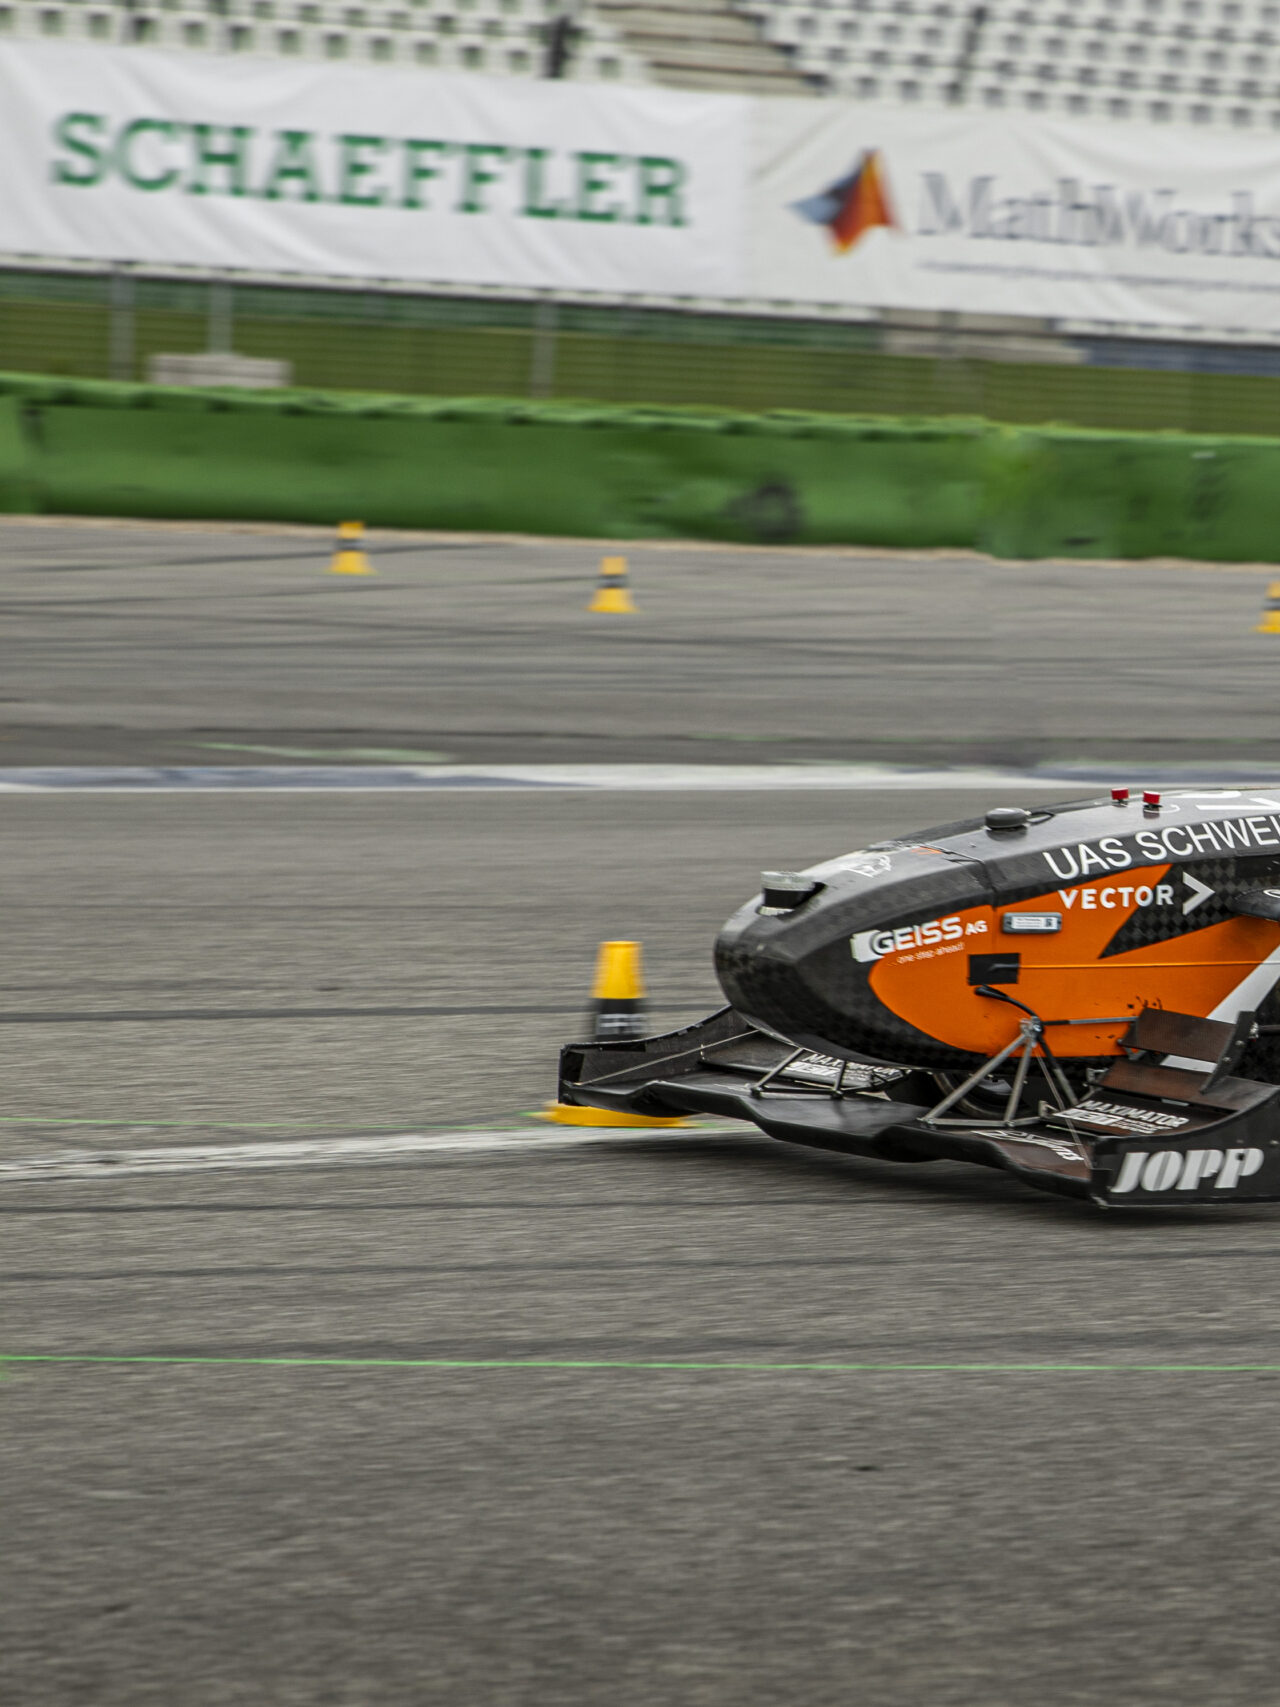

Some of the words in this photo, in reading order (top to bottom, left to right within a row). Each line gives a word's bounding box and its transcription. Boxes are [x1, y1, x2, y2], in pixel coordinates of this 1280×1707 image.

[51, 111, 688, 228] SCHAEFFLER
[1042, 838, 1132, 880] UAS
[1058, 884, 1174, 910] VECTOR
[872, 917, 964, 955] GEISS
[965, 920, 988, 936] AG
[1075, 1100, 1190, 1128] MAXIMATOR
[1110, 1147, 1265, 1194] JOPP
